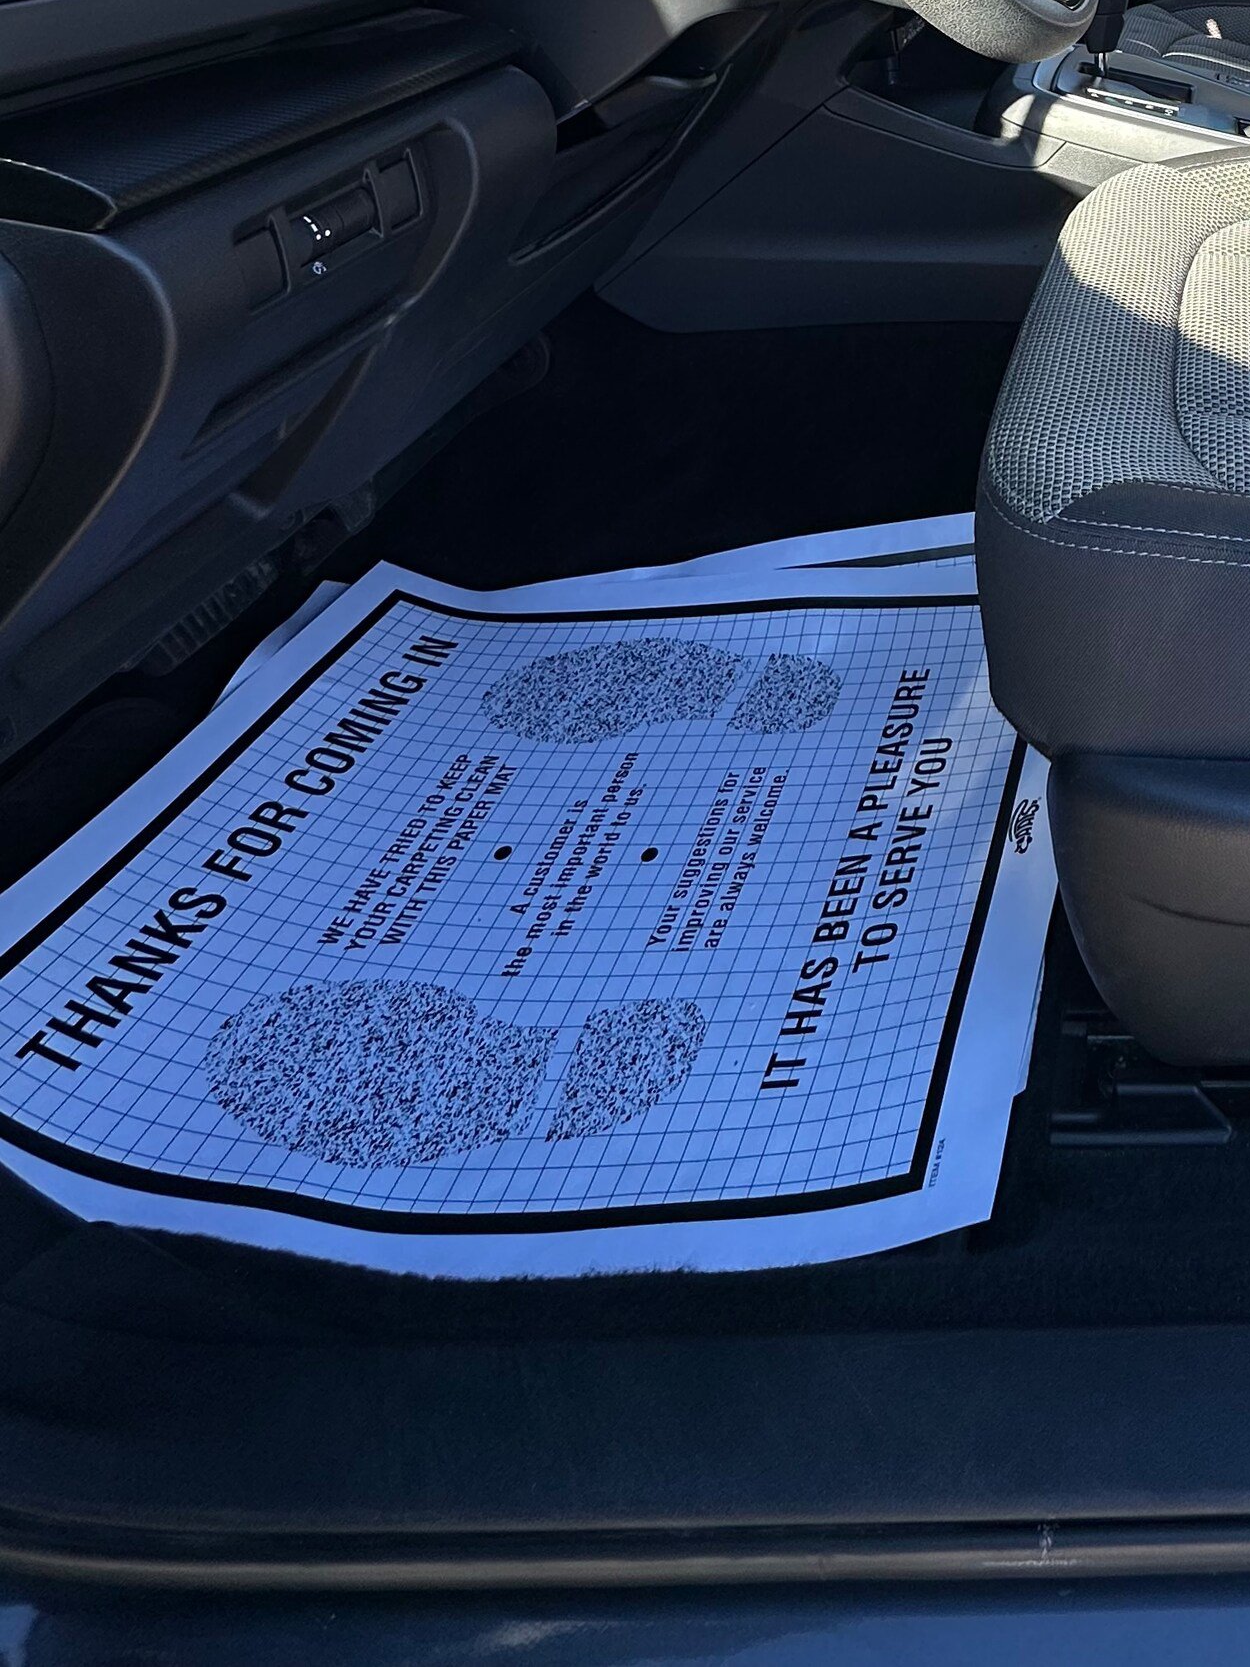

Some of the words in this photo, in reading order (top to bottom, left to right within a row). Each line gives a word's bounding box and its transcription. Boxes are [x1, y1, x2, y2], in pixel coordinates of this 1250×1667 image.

[856, 668, 930, 813] PLEASURE
[906, 737, 953, 797] YOU
[15, 886, 228, 1071] THANKS
[202, 800, 309, 881] FOR
[284, 670, 428, 796] COMING
[402, 635, 459, 667] IN
[317, 916, 354, 944] WE
[343, 868, 390, 913] HAVE
[379, 818, 427, 864] TRIED
[417, 794, 446, 814] TO
[437, 753, 472, 790] KEEP
[344, 901, 396, 951] YOUR
[387, 806, 464, 897] CARPETING
[454, 755, 499, 802] CLEAN
[379, 899, 427, 945] WITH
[415, 855, 457, 892] THIS
[447, 800, 495, 850] PAPER
[485, 764, 517, 794] MAT
[501, 946, 532, 977] the
[526, 894, 561, 939] most
[555, 806, 609, 888] important
[601, 752, 639, 805] person
[510, 902, 531, 915] A
[523, 818, 577, 897] customer
[567, 799, 588, 814] is
[551, 919, 575, 936] in
[564, 884, 592, 913] the
[586, 832, 621, 879] world
[610, 811, 632, 827] to
[624, 783, 647, 807] us.
[646, 905, 681, 948] Your
[673, 798, 729, 899] suggestions
[718, 771, 740, 794] for
[671, 861, 729, 952] improving
[718, 829, 740, 855] our
[732, 766, 766, 824] service
[704, 918, 728, 949] are
[720, 851, 756, 912] always
[747, 769, 790, 847] welcome.
[812, 854, 872, 943] BEEN
[848, 821, 883, 841] A
[872, 804, 933, 910] SERVE
[780, 956, 838, 1036] HAS
[852, 923, 898, 973] TO
[760, 1053, 807, 1089] IT
[928, 1162, 940, 1188] ITEM
